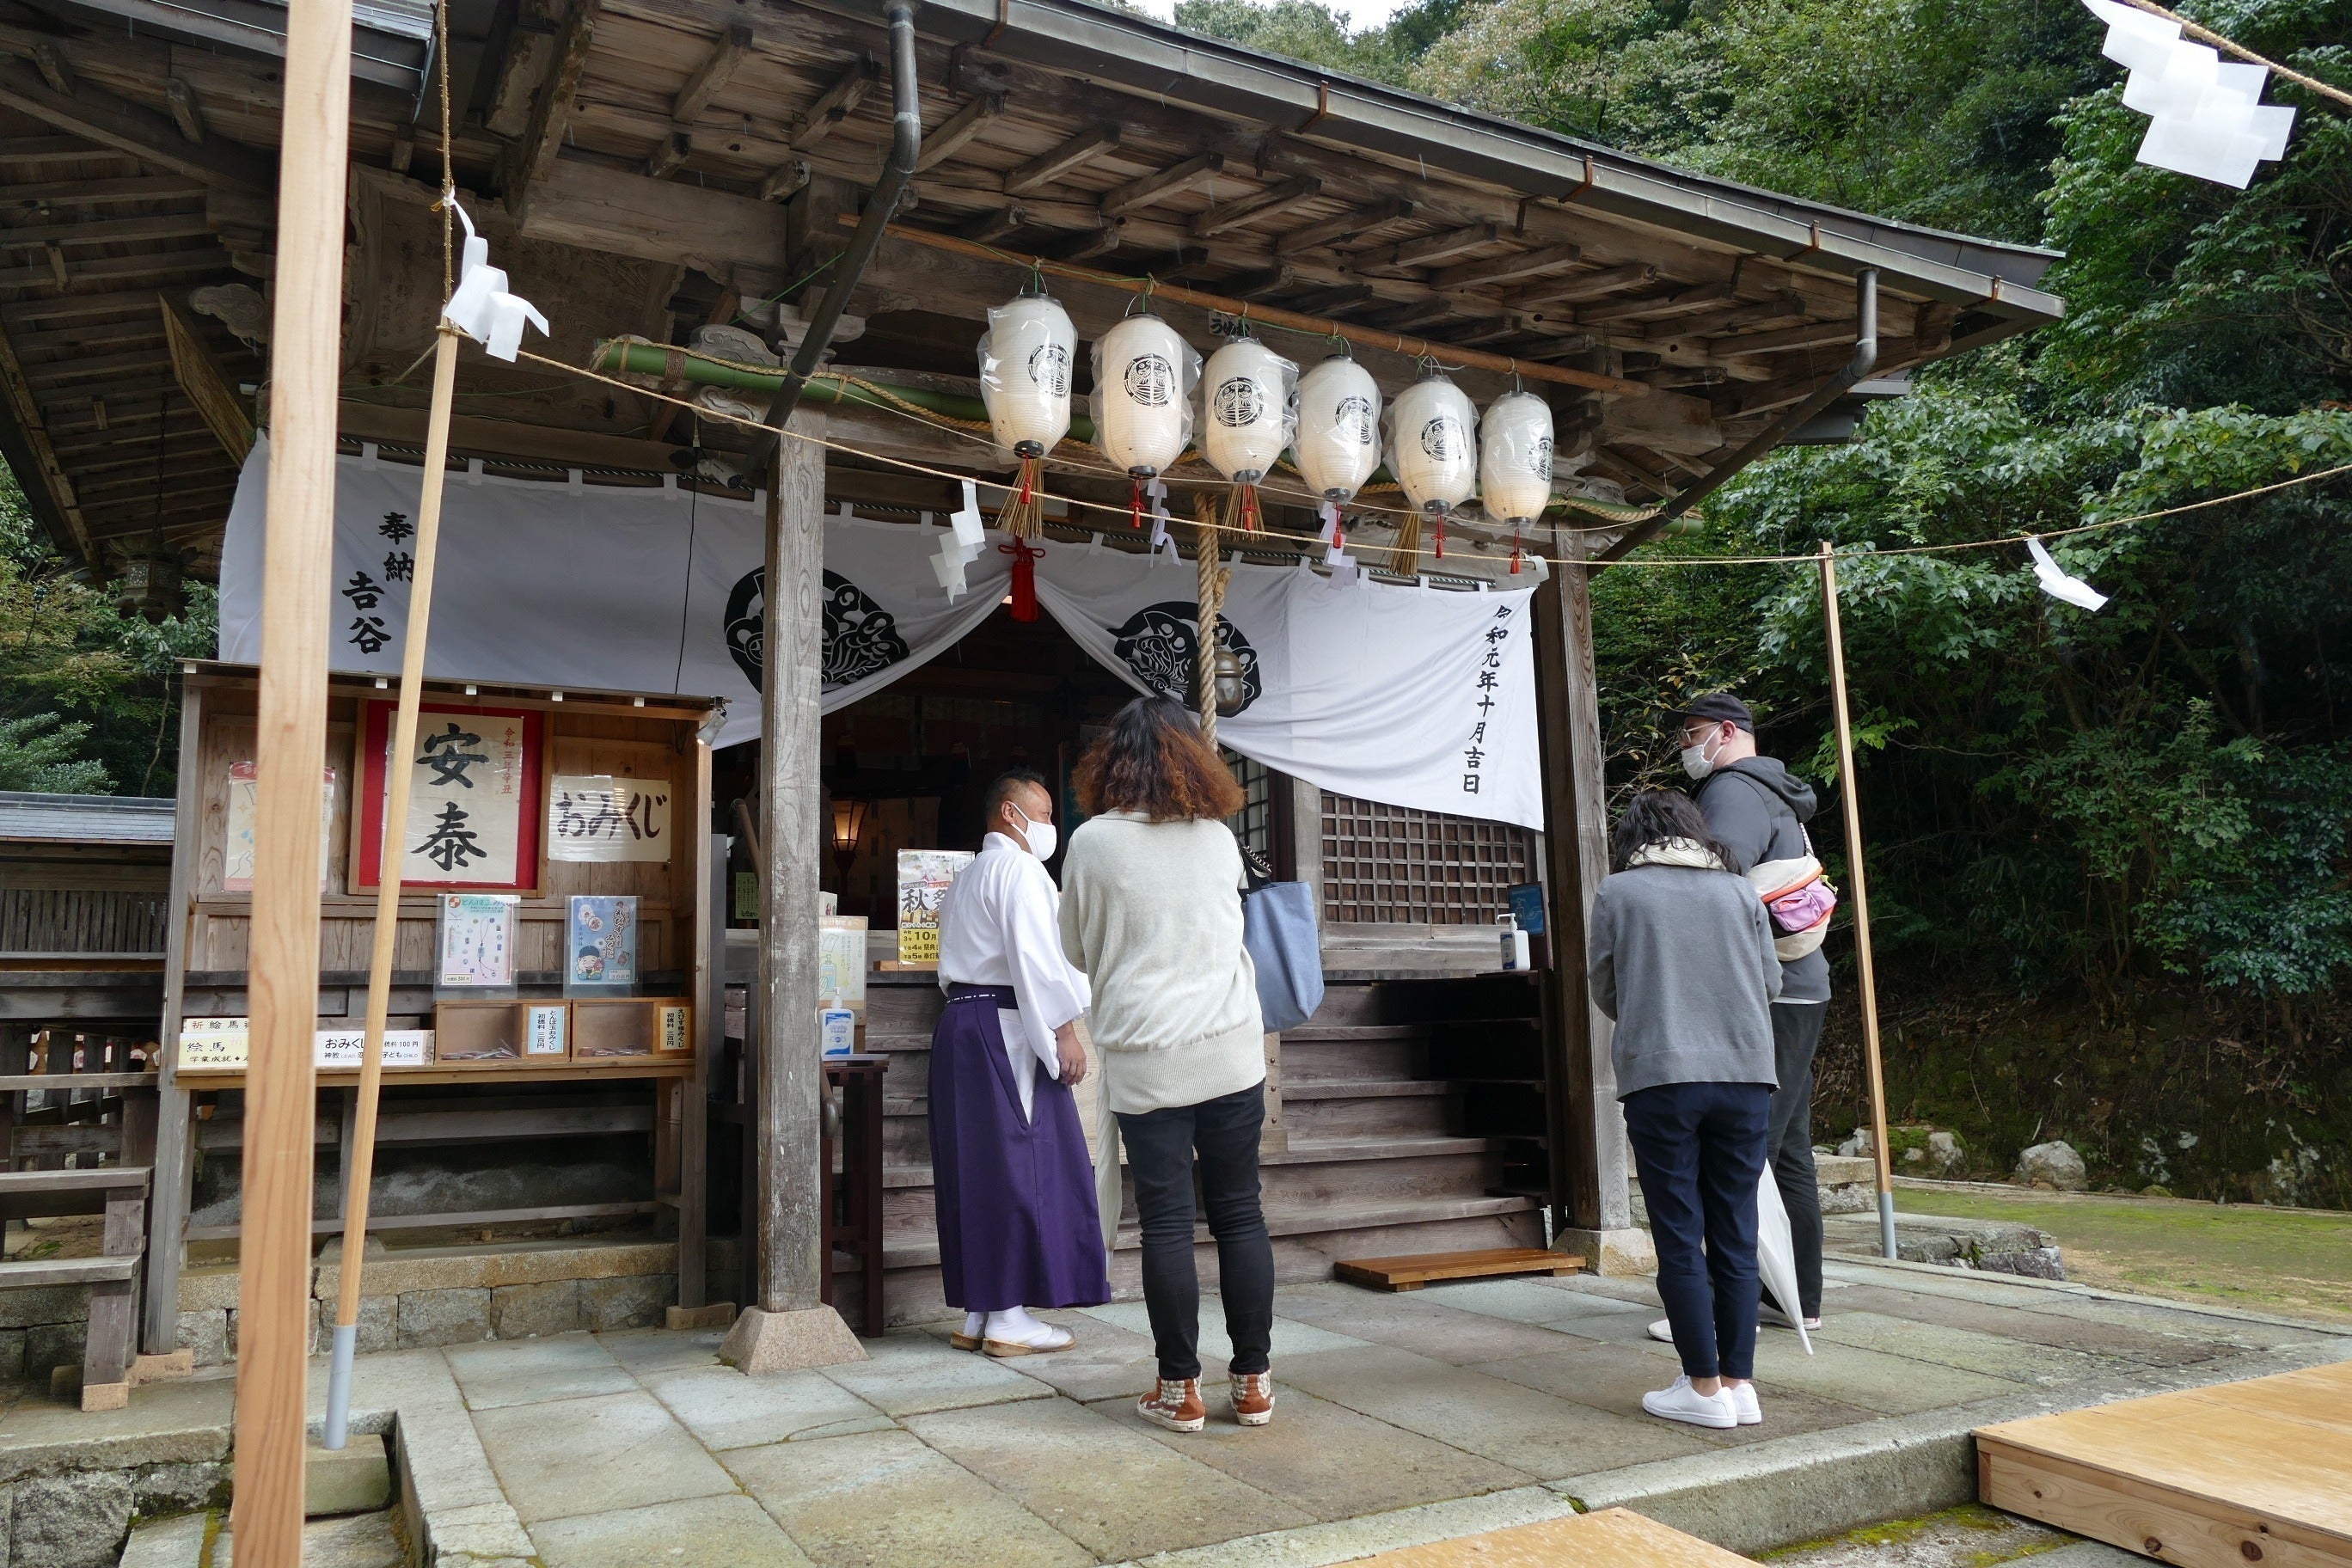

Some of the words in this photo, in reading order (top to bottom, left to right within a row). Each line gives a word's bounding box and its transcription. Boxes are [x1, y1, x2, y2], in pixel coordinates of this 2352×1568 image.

[378, 511, 415, 584] 奉納
[341, 571, 392, 672] 吉谷
[1464, 604, 1512, 794] 令和元年十月吉日
[411, 722, 490, 871] 安泰
[500, 726, 516, 794] 令和三年辛丑
[555, 792, 668, 841] おみくじ
[915, 931, 937, 940] 10月
